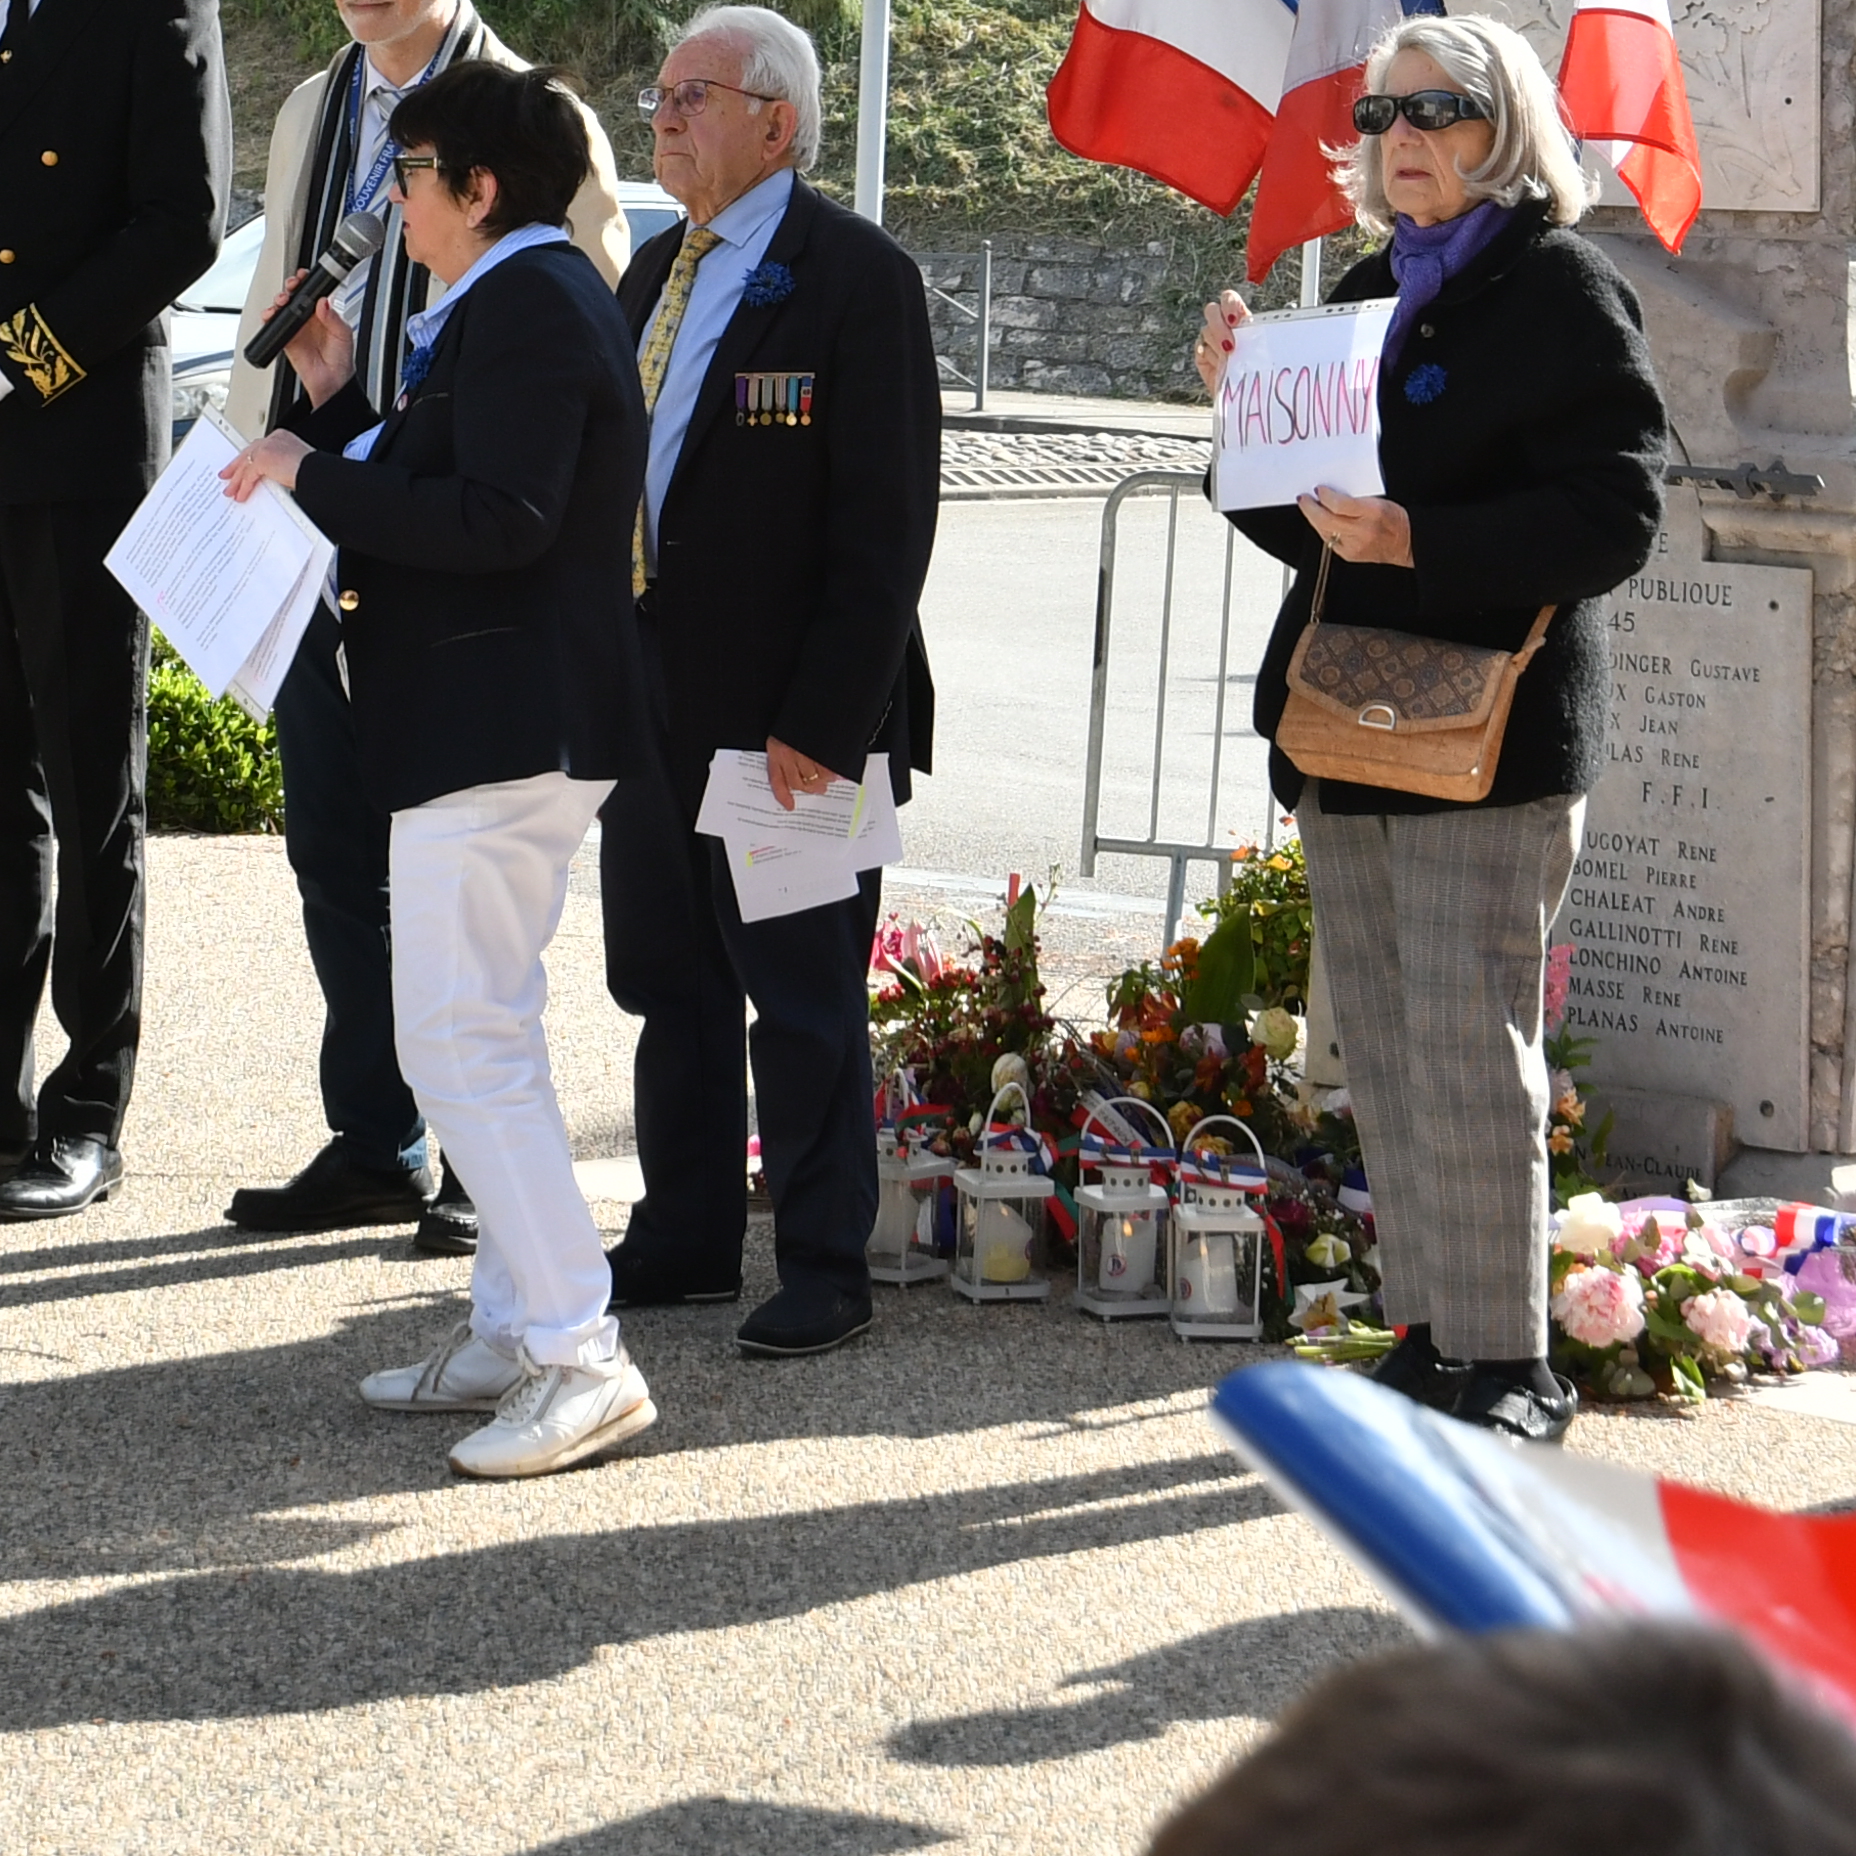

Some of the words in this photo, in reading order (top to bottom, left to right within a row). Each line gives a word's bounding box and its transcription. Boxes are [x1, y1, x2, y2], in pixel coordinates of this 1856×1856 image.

[352, 163, 386, 213] SOUVENIR
[1222, 356, 1379, 454] MAISONNY
[1628, 578, 1733, 606] PUBLIQUE
[1690, 659, 1760, 682] GUSTAVE
[1645, 686, 1706, 708] GASTON
[1640, 715, 1678, 734] JEAN
[1661, 749, 1699, 768] RENE
[1586, 832, 1660, 856] UGOYAT
[1678, 841, 1717, 862] RENE
[1647, 867, 1696, 889] PIERRE
[1571, 889, 1655, 914] CHALEAT
[1674, 900, 1725, 922] ANDRE
[1570, 919, 1681, 948] GALLINOTTI
[1701, 934, 1738, 955] RENE
[1570, 948, 1660, 974] LONCHINO
[1679, 962, 1747, 986] ANTOINE
[1569, 977, 1624, 1000] MASSE
[1644, 986, 1681, 1007] RENE
[1568, 1007, 1638, 1032] PLANAS
[1656, 1019, 1723, 1043] ANTOINE
[1605, 1152, 1701, 1181] EAN-CLAUDE
